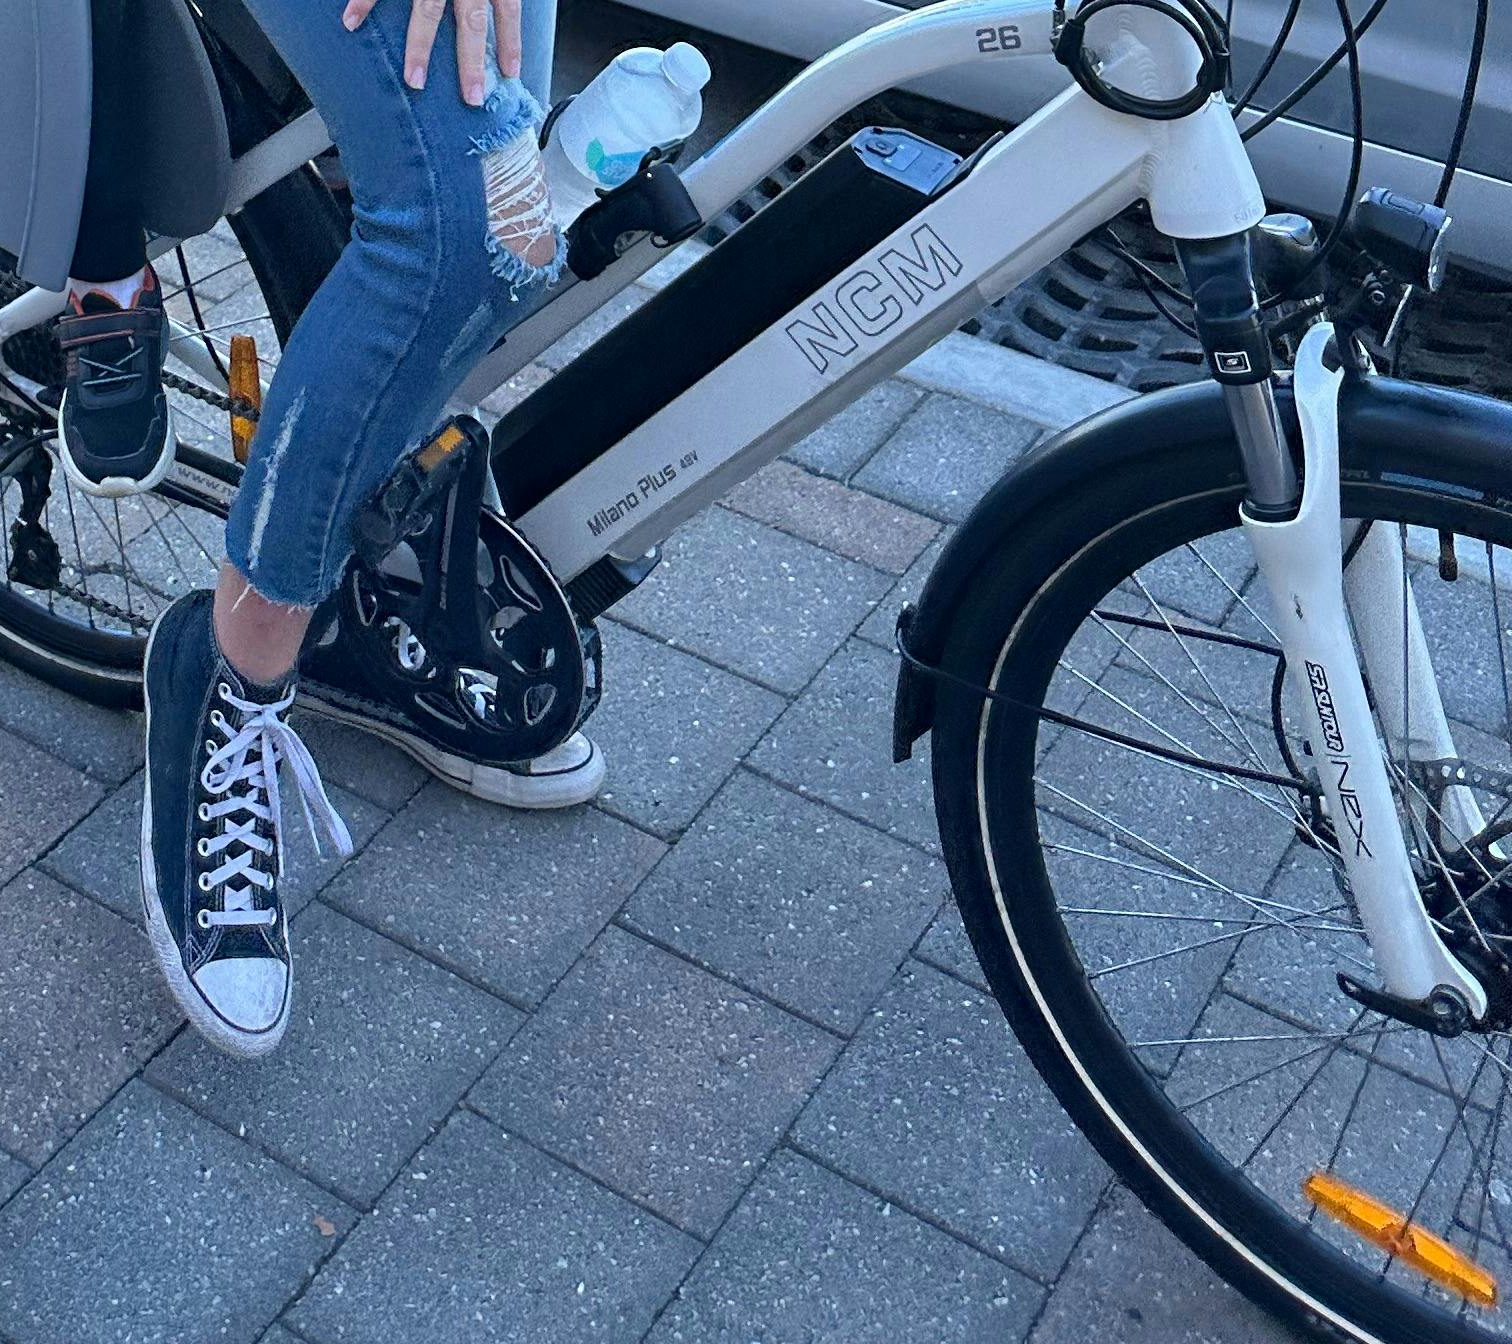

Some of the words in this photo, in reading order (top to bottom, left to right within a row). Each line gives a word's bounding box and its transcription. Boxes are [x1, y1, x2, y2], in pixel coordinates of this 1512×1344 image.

[975, 25, 1022, 53] 26
[785, 223, 964, 375] NCM
[586, 491, 640, 537] Milano
[636, 464, 677, 499] Plus
[1331, 760, 1373, 858] NEX
